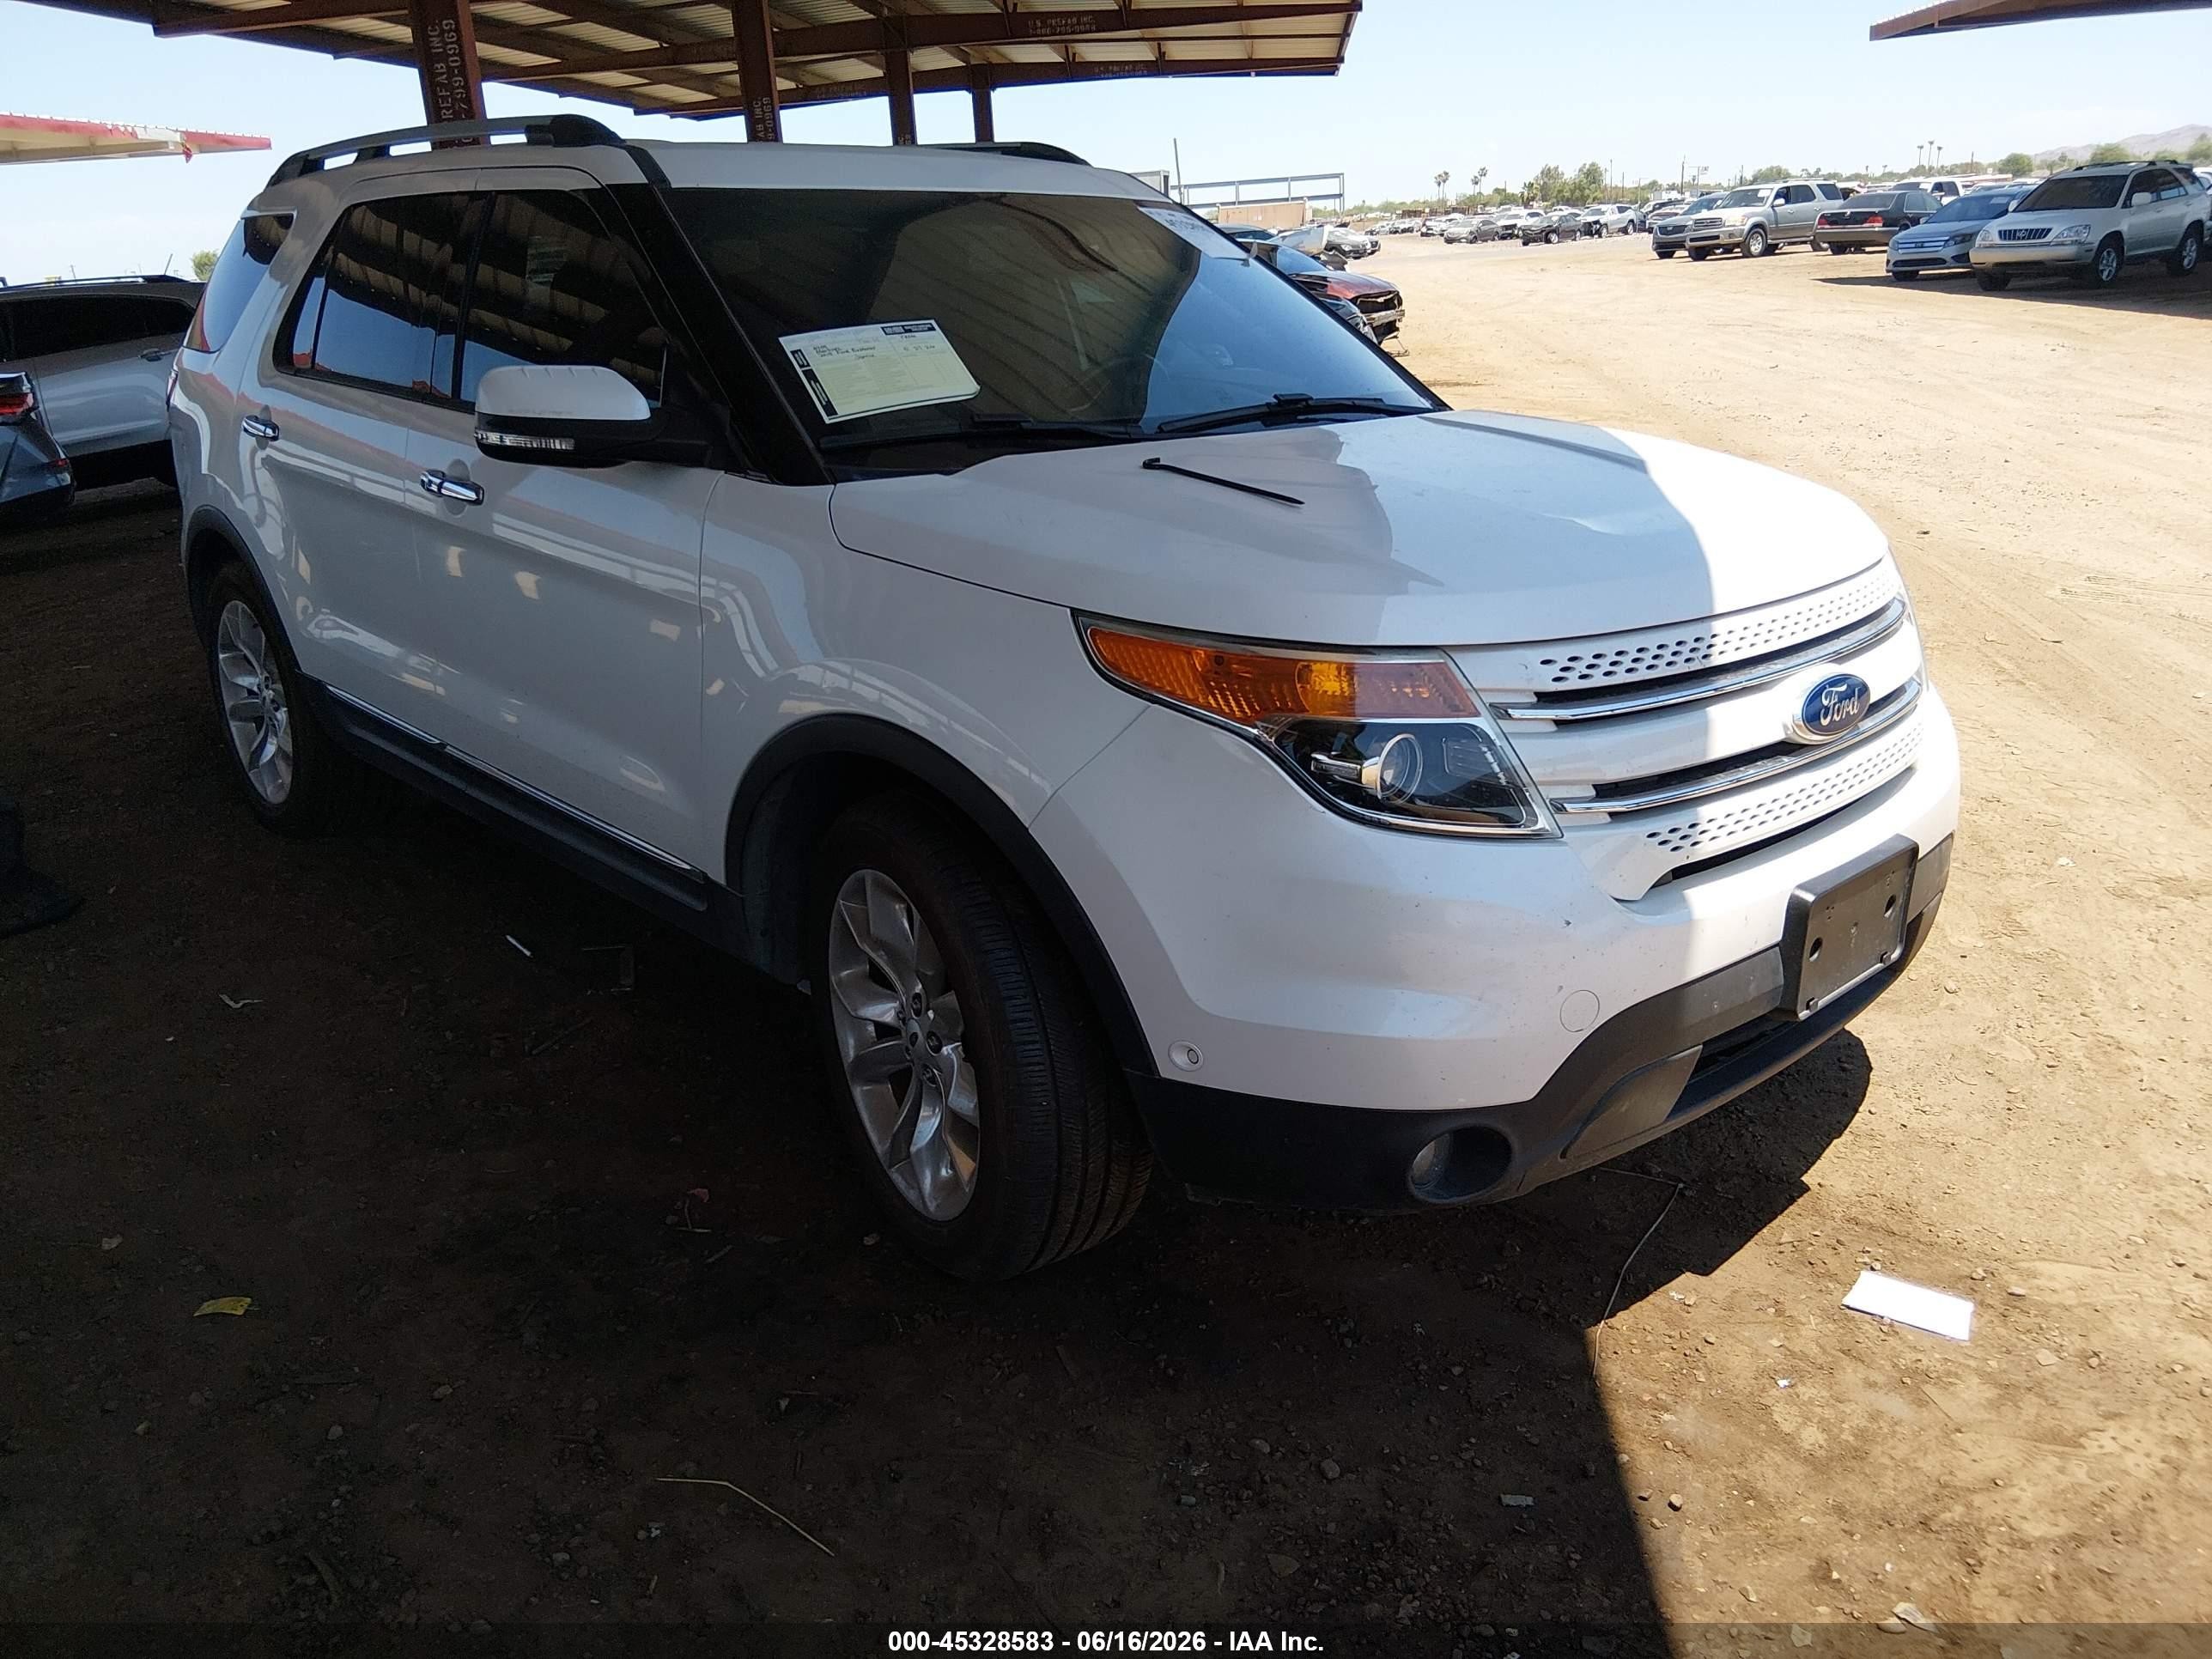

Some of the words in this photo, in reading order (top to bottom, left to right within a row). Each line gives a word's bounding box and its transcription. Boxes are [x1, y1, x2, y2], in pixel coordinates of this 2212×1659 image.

[428, 20, 444, 53] INC.
[1047, 16, 1078, 27] PREFAB
[434, 63, 454, 119] REFAB
[1820, 684, 1860, 726] Ford
